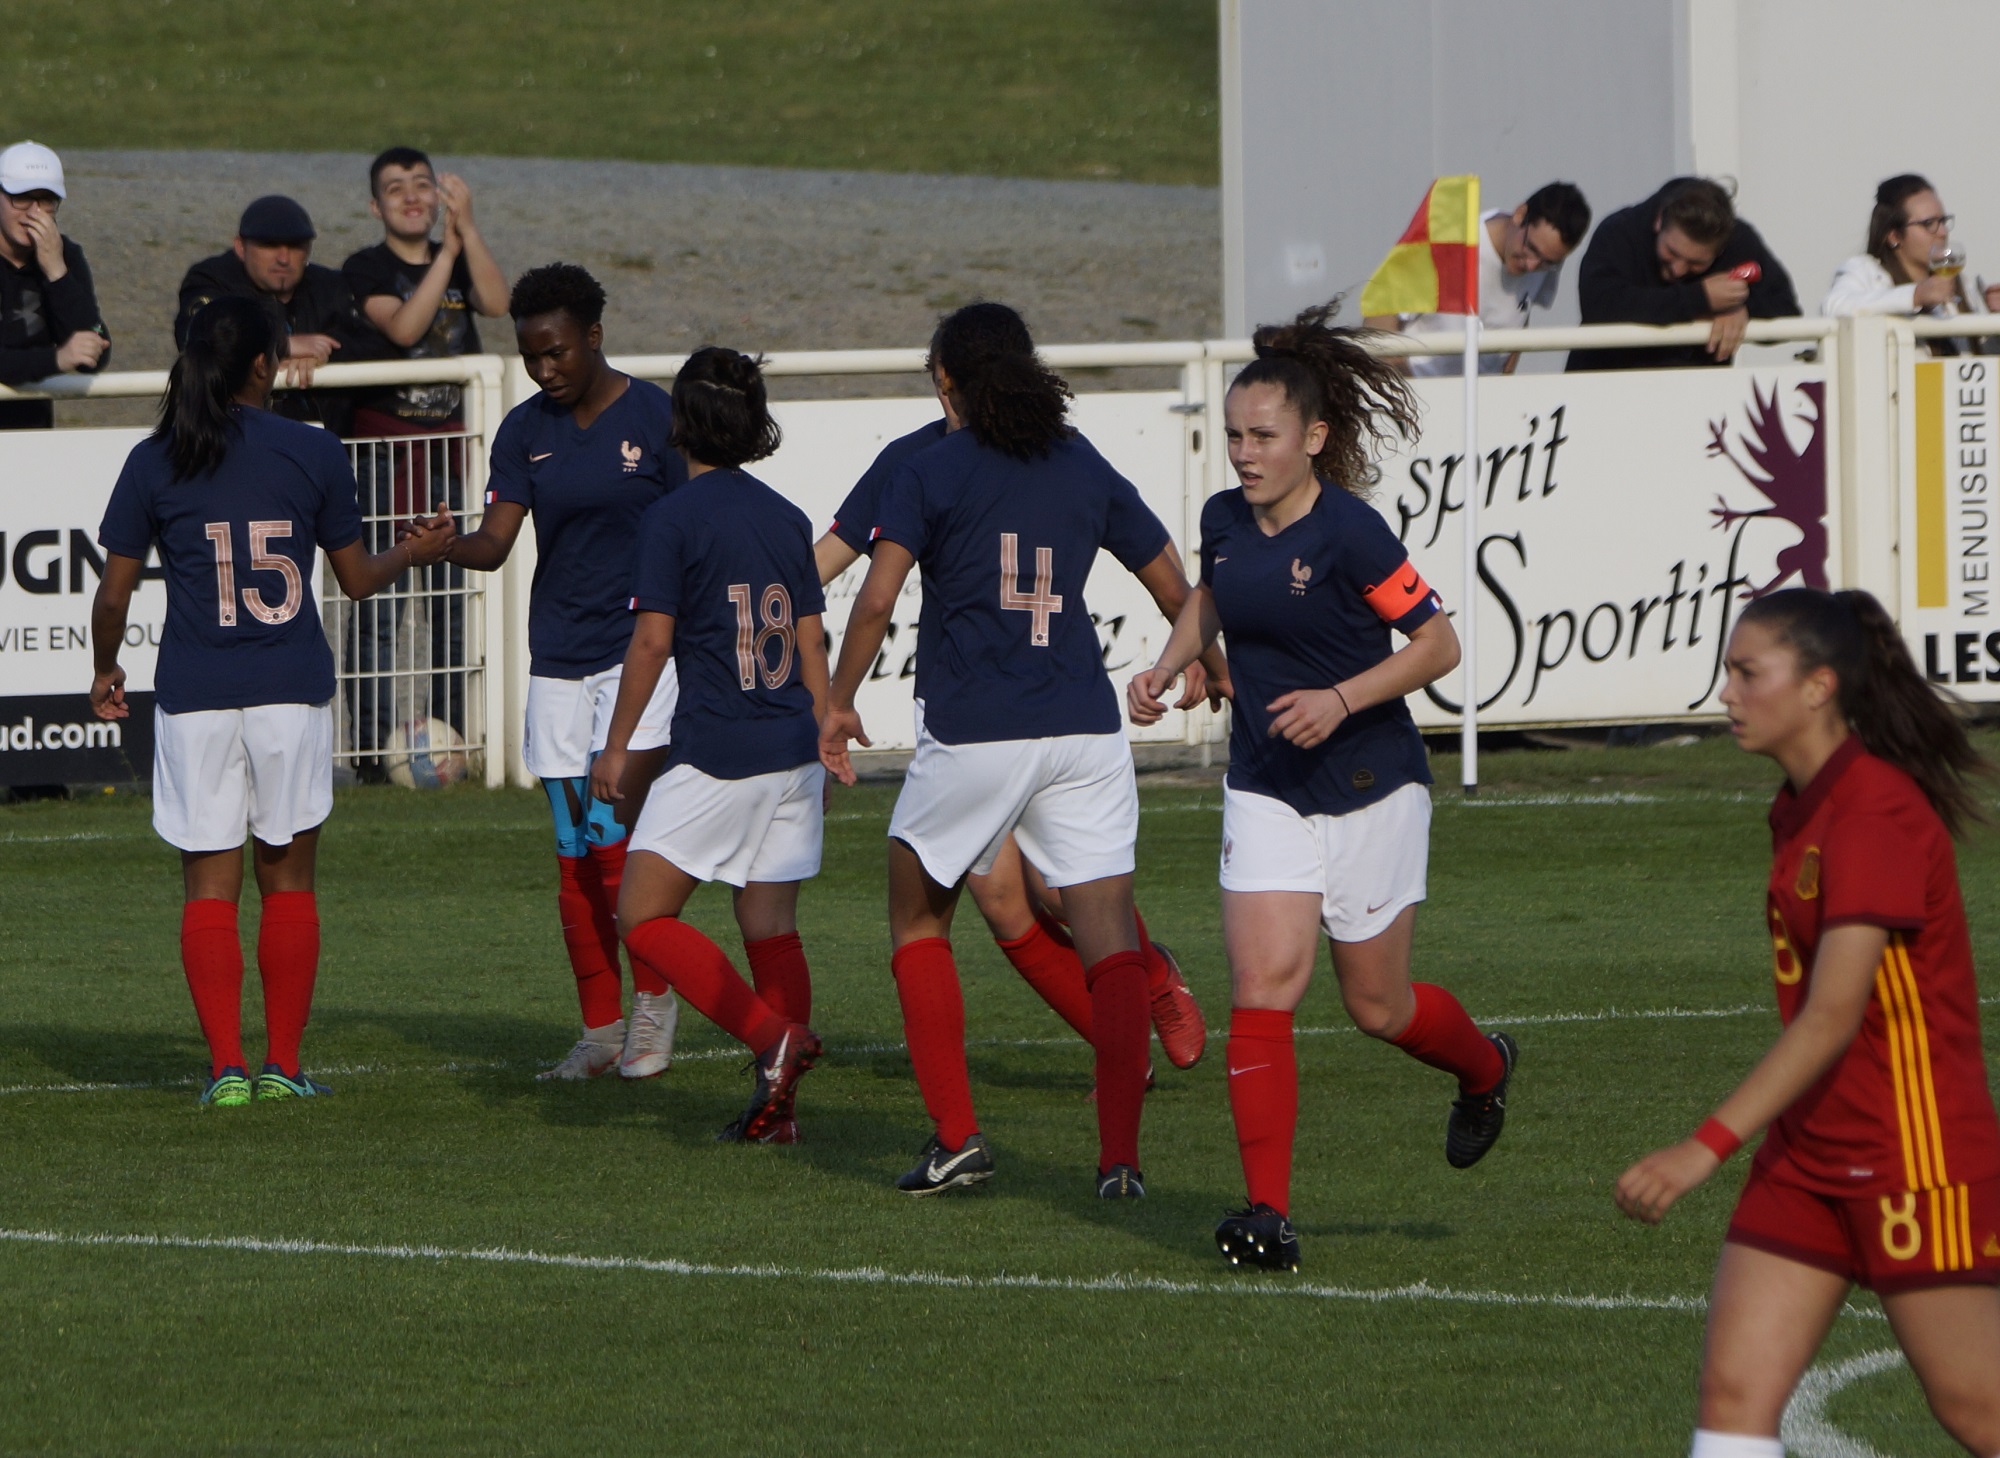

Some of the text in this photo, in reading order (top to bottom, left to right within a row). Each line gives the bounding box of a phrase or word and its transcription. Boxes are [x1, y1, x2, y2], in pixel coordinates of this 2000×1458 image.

[1396, 404, 1569, 549] sprit
[1958, 361, 1989, 617] MENUISERIES
[205, 520, 303, 627] 15
[1000, 533, 1062, 647] 4
[1423, 515, 1751, 714] Sportif
[50, 625, 87, 650] EN
[728, 583, 796, 691] 18
[1879, 1191, 1922, 1261] 8
